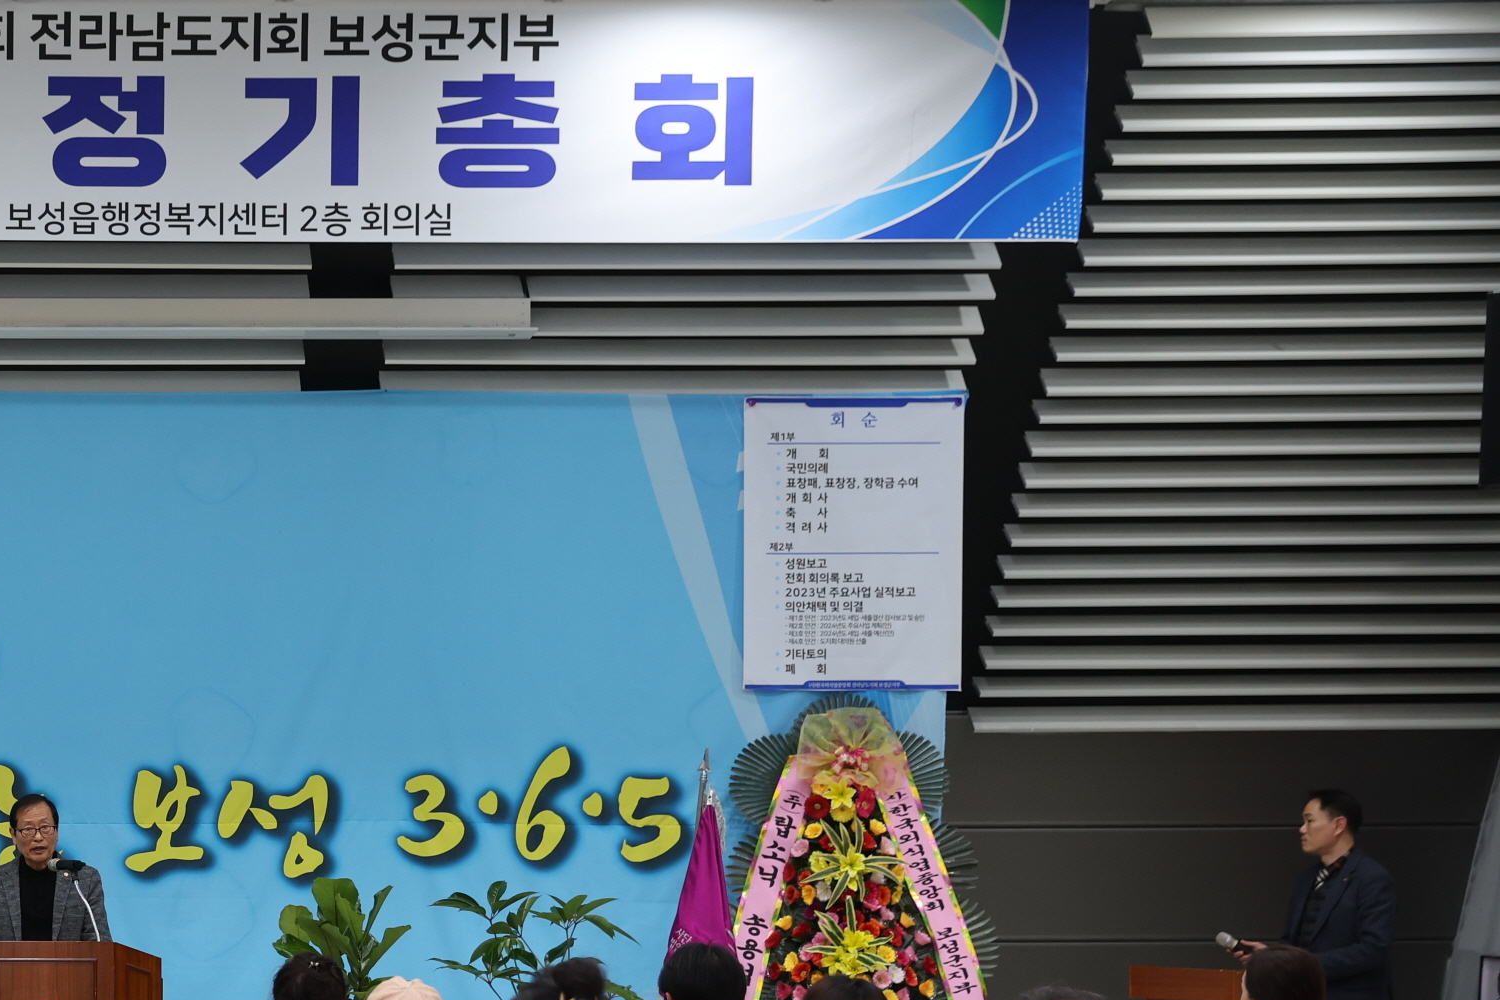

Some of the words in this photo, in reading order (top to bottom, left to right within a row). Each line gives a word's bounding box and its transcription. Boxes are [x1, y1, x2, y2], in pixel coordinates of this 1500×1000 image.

[29, 12, 309, 62] 전라남도지회
[323, 14, 559, 62] 보성군지부
[5, 202, 288, 236] 보성읍행정복지센터
[300, 203, 352, 237] 2층
[360, 203, 452, 237] 회의실
[770, 432, 795, 442] 제1부
[786, 462, 829, 475] 국민의례
[786, 477, 822, 490] 표창패,
[824, 477, 860, 490] 표창장,
[863, 477, 895, 490] 장학금
[897, 477, 919, 490] 수여
[769, 542, 793, 552] 제2부
[785, 558, 828, 570] 성원보고
[785, 572, 806, 585] 전회
[808, 572, 841, 585] 회의록
[842, 572, 864, 584] 보고
[785, 587, 826, 599] 2023년
[828, 587, 871, 599] 주요사업
[874, 586, 916, 599] 실적보고
[785, 601, 827, 613] 의안채택
[829, 601, 840, 613] 및
[842, 601, 864, 613] 의결
[785, 648, 827, 661] 기타토의
[124, 764, 330, 879] 보성
[935, 926, 978, 995] 보성군지부
